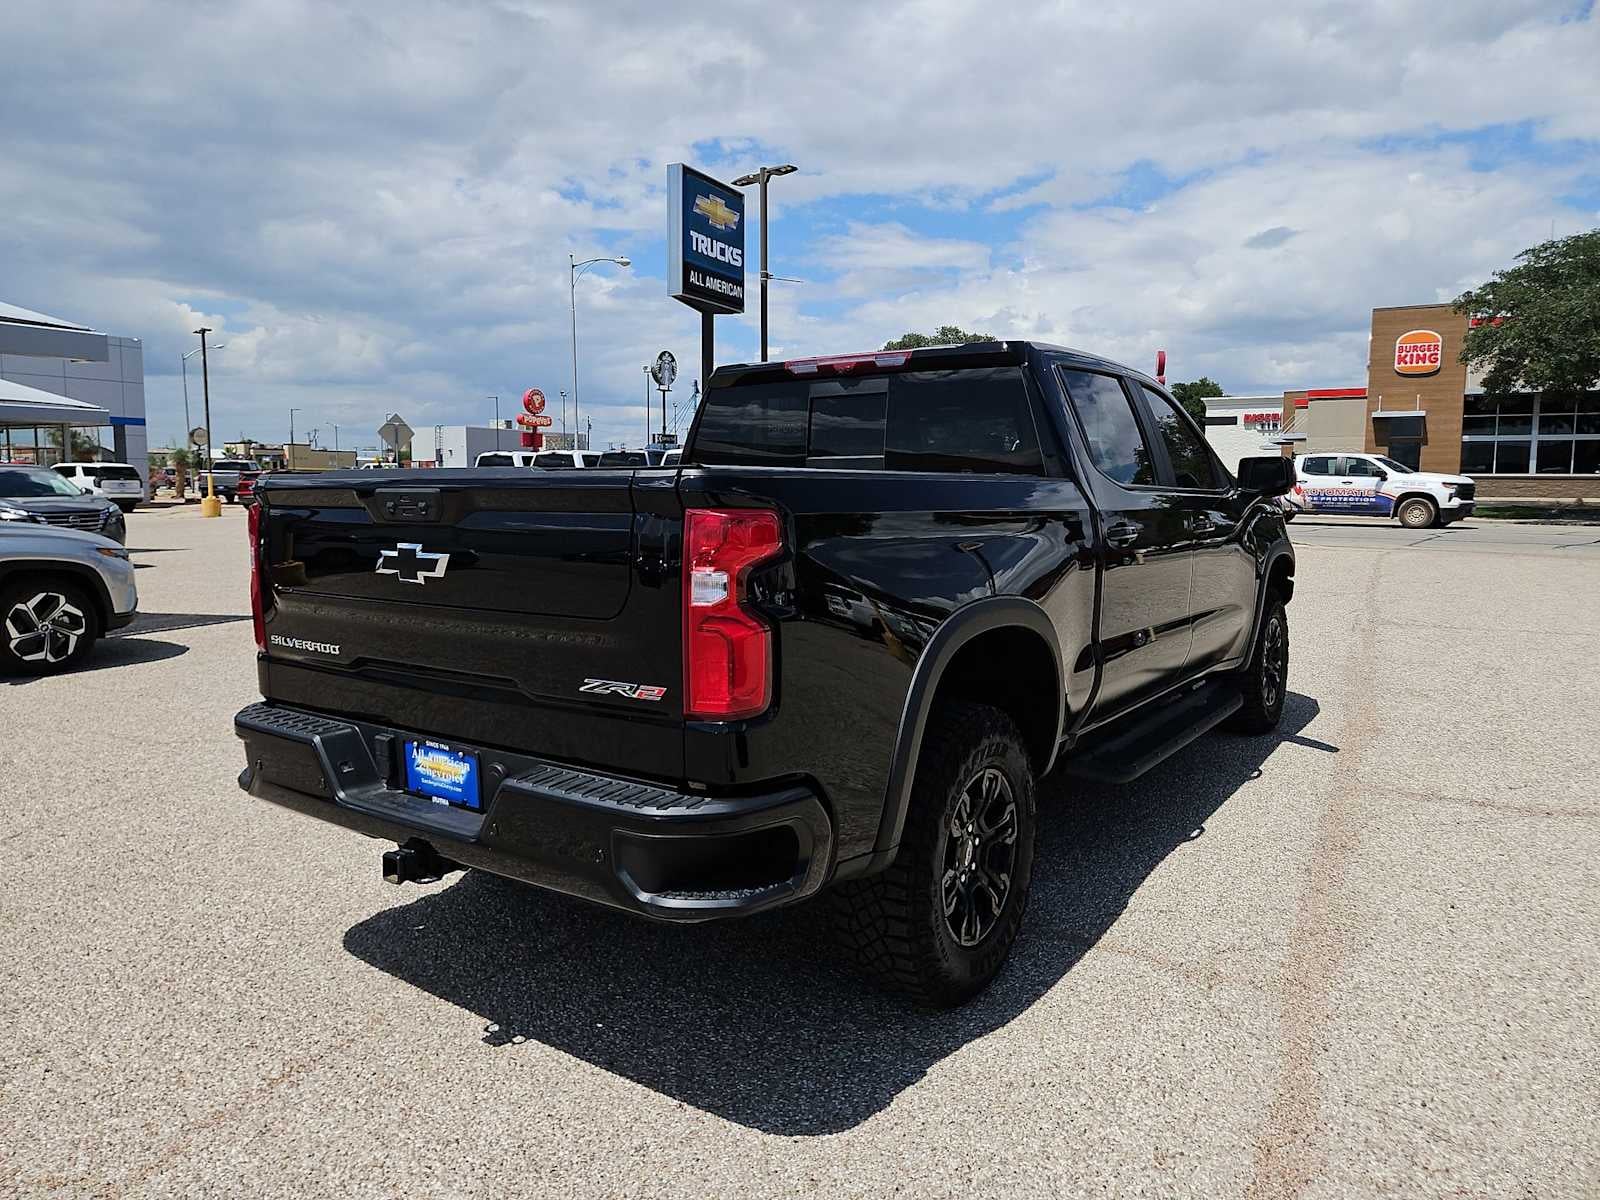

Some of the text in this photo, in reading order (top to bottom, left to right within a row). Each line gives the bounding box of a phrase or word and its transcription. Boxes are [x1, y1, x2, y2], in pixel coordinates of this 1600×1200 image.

[690, 230, 742, 267] TRUCKS
[689, 270, 743, 299] ALL AMERICAN
[1396, 353, 1439, 366] KING
[1397, 344, 1440, 354] BURGER
[1260, 422, 1282, 431] TIR
[270, 634, 340, 655] SILVERADO
[578, 678, 667, 701] ZR2
